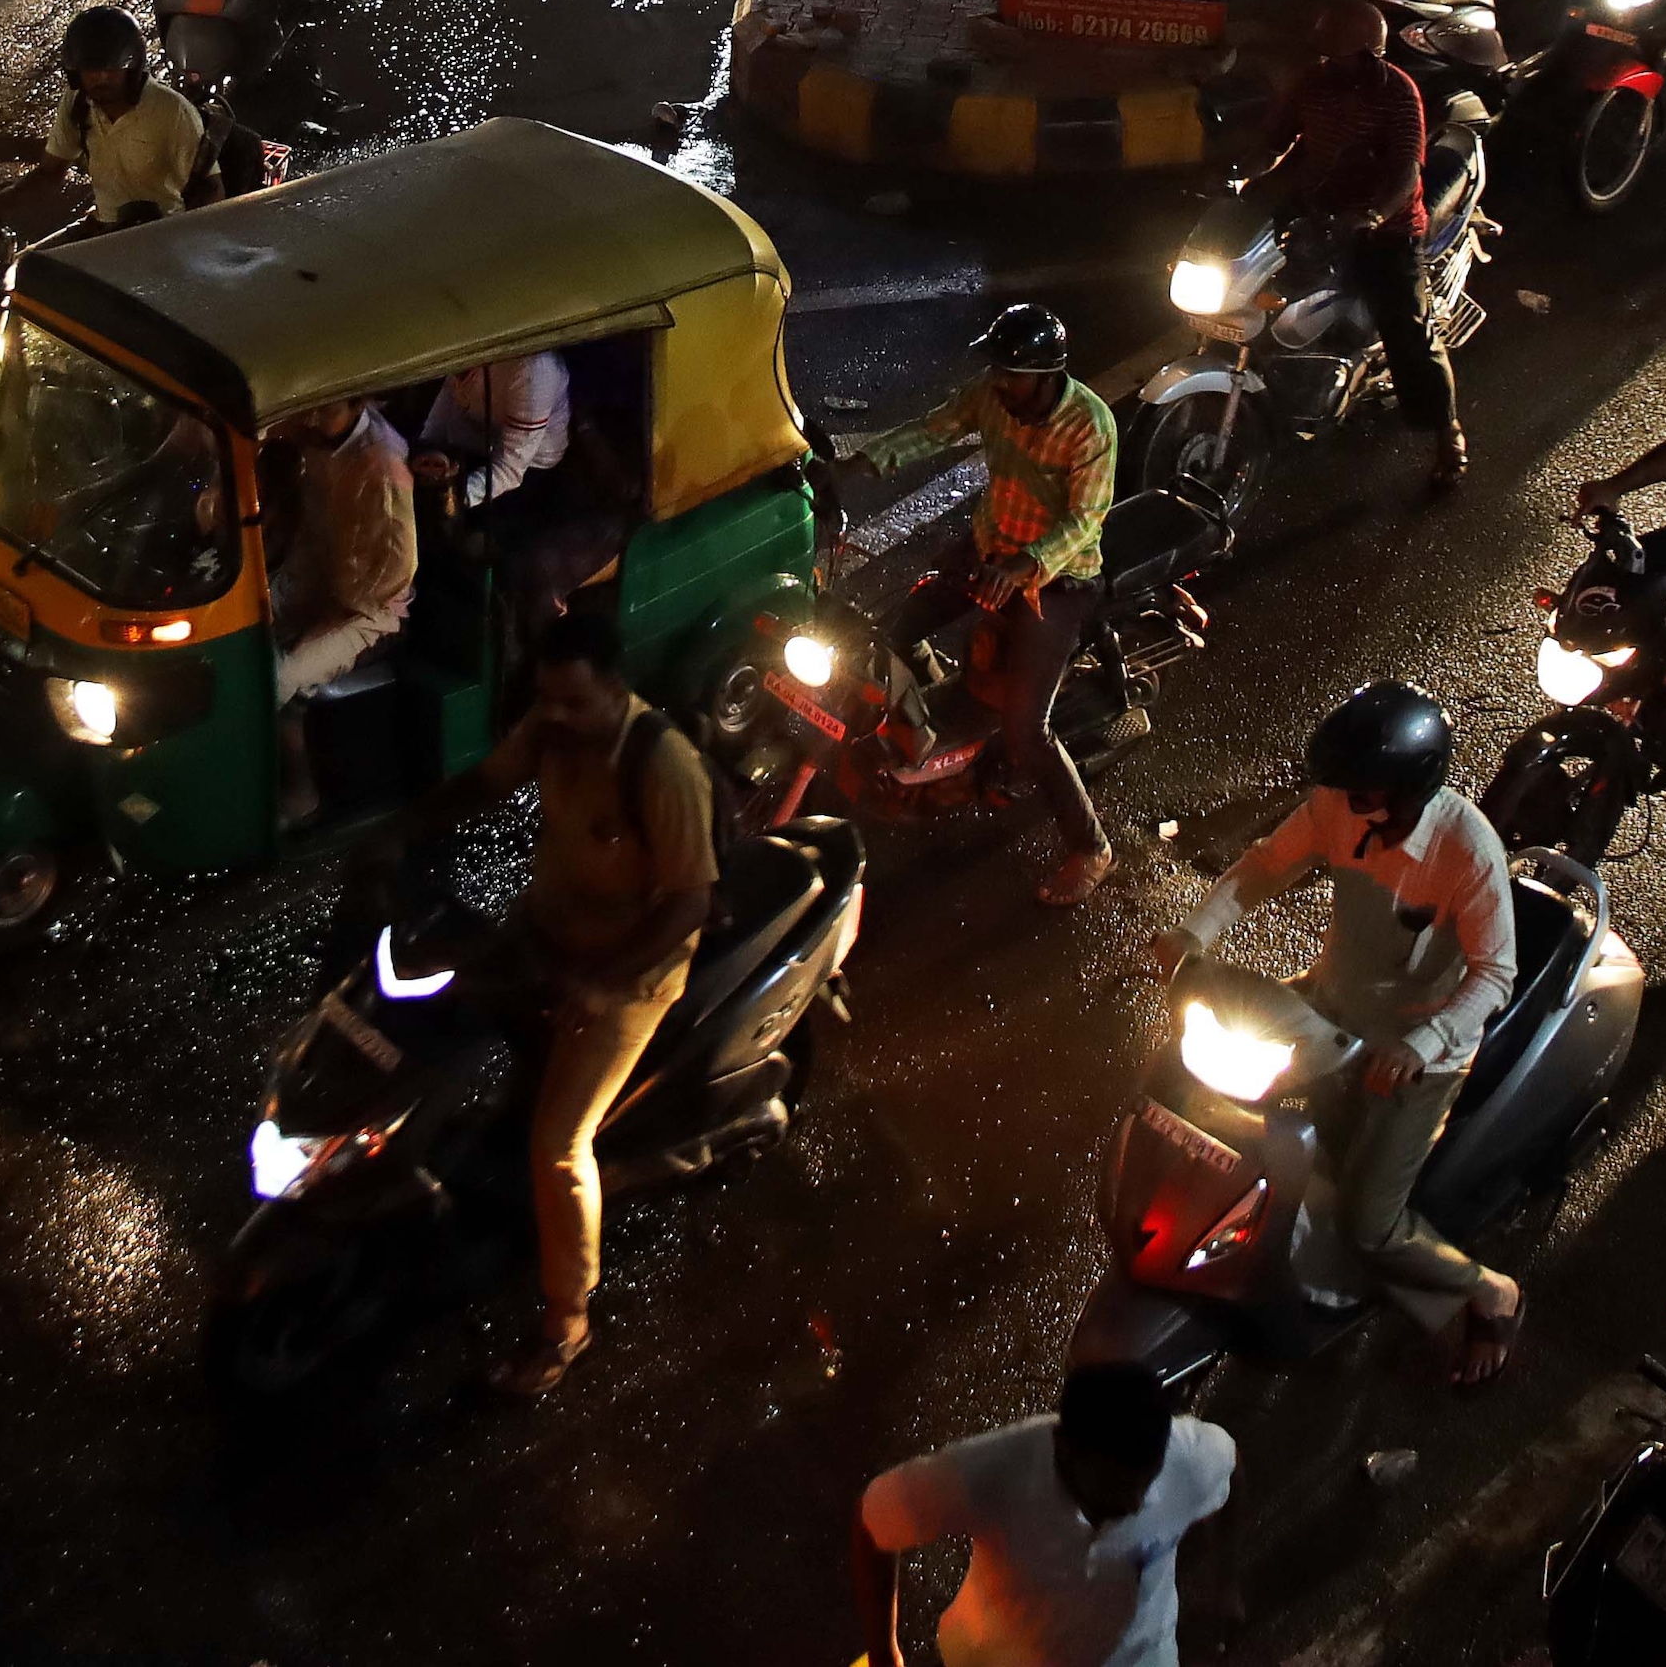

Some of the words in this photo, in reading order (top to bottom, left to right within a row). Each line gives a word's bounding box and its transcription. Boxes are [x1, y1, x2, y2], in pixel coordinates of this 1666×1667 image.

[1017, 11, 1064, 33] Mob:
[1071, 14, 1133, 40] 82174
[1138, 19, 1209, 47] 26669
